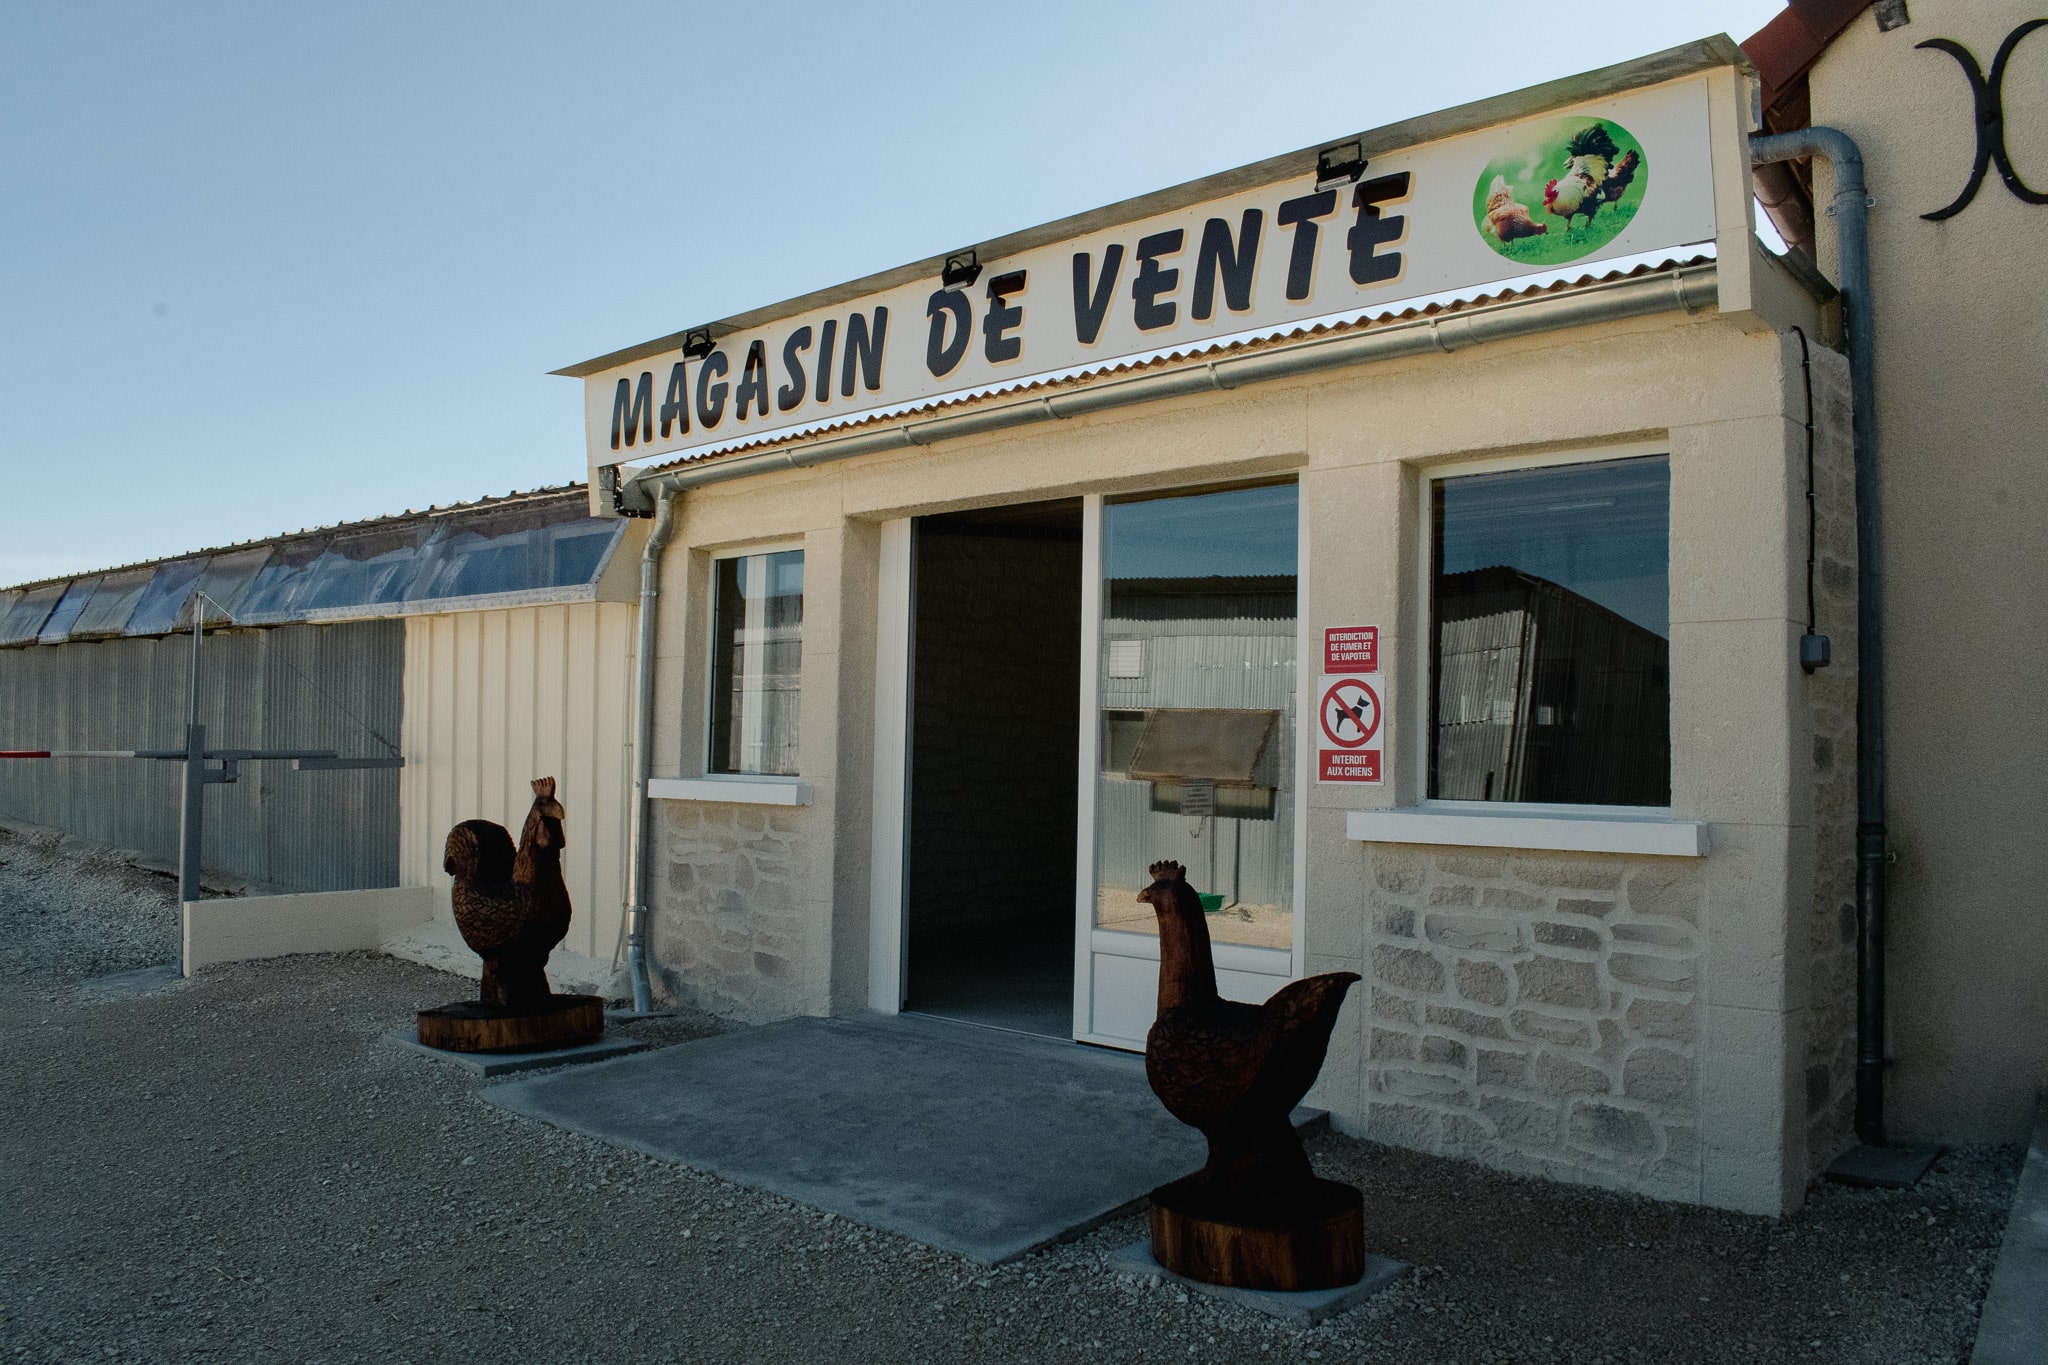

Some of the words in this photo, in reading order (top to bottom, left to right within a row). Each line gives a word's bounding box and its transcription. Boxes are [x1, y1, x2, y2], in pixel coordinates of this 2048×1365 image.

[610, 306, 889, 450] MAGASIN
[926, 269, 1028, 378] DE
[1072, 171, 1411, 345] VENTE
[1329, 632, 1374, 641] INTERDICTION
[1330, 643, 1340, 651] DE
[1340, 642, 1363, 651] FUMER
[1363, 641, 1372, 650] ET
[1331, 653, 1340, 661] DE
[1341, 652, 1371, 660] VAPOTER
[1332, 755, 1367, 765] INTERDIT
[1327, 766, 1343, 776] AUX
[1344, 767, 1373, 776] CHIENS
